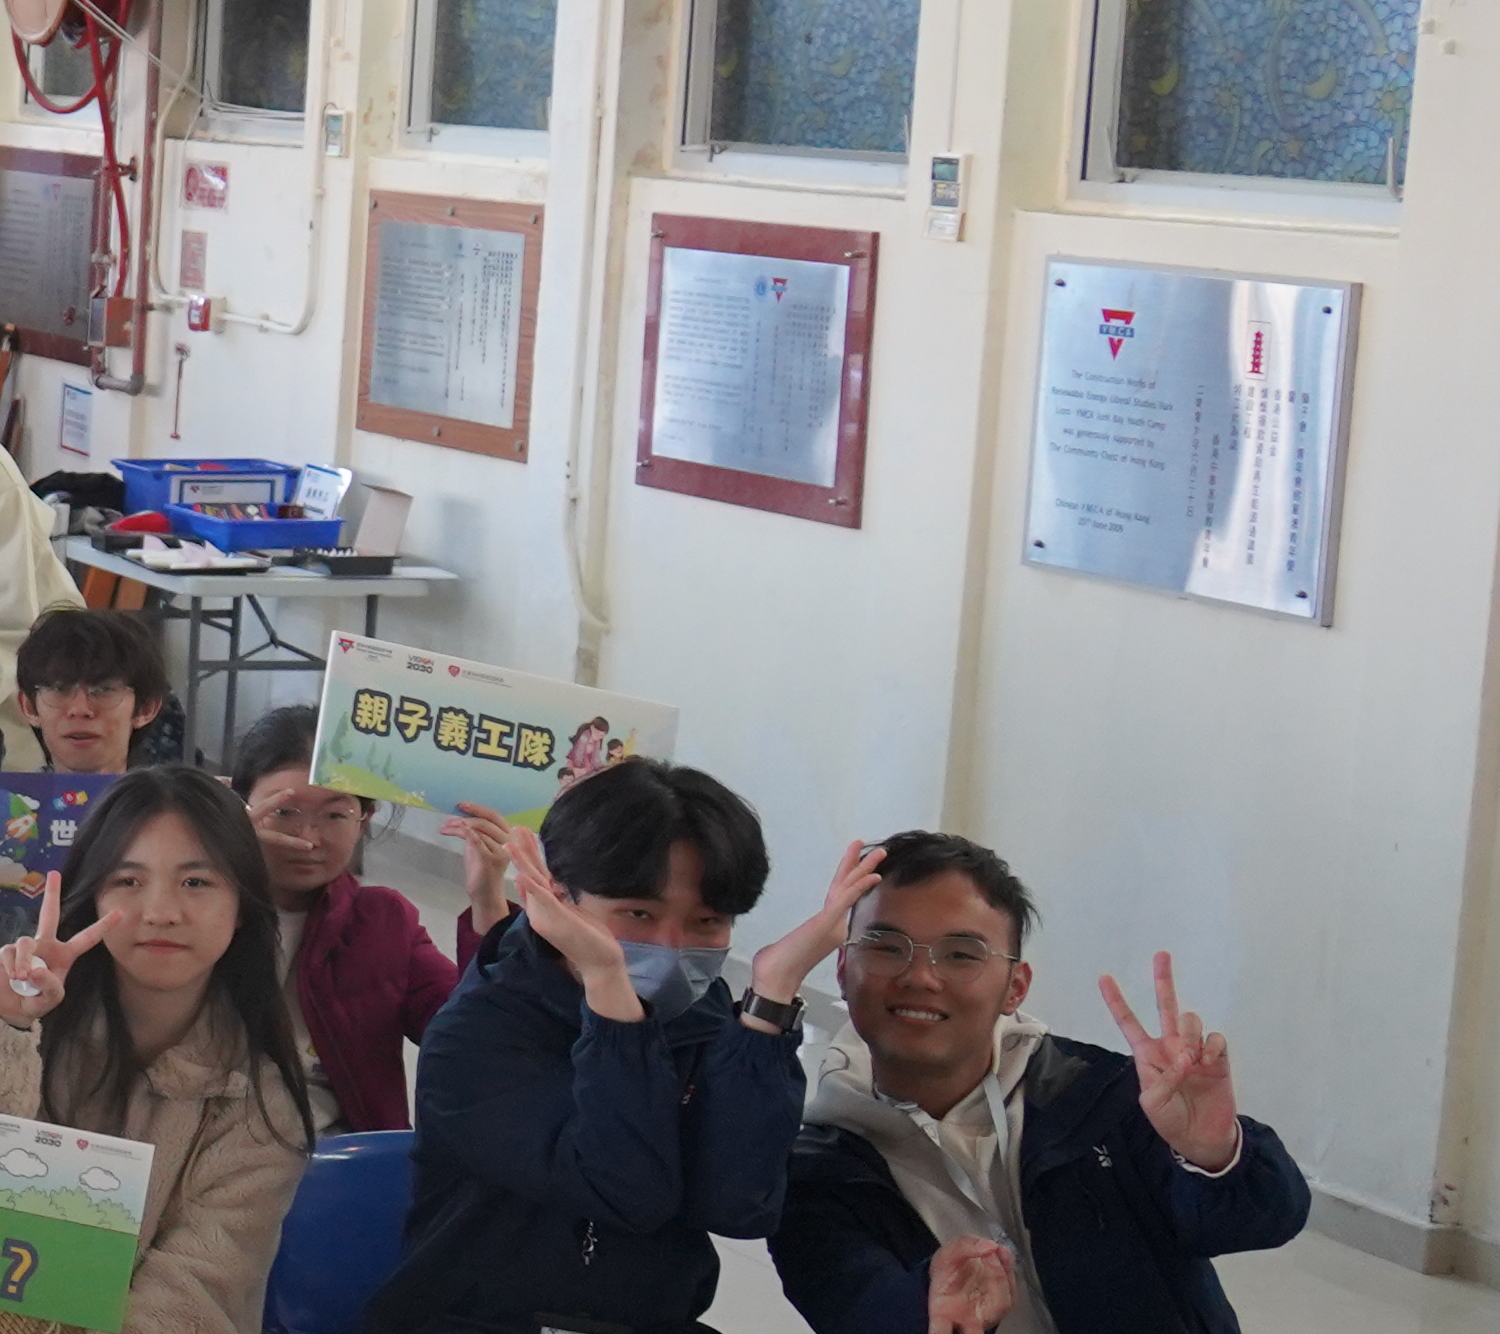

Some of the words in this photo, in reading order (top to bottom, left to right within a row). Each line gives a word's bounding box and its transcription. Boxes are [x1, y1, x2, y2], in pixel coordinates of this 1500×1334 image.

[1100, 324, 1135, 338] YMCA
[407, 662, 434, 674] 2030
[353, 689, 556, 771] 親子義工隊
[50, 819, 78, 847] 世
[36, 1128, 63, 1141] VISION
[34, 1136, 62, 1148] 2030
